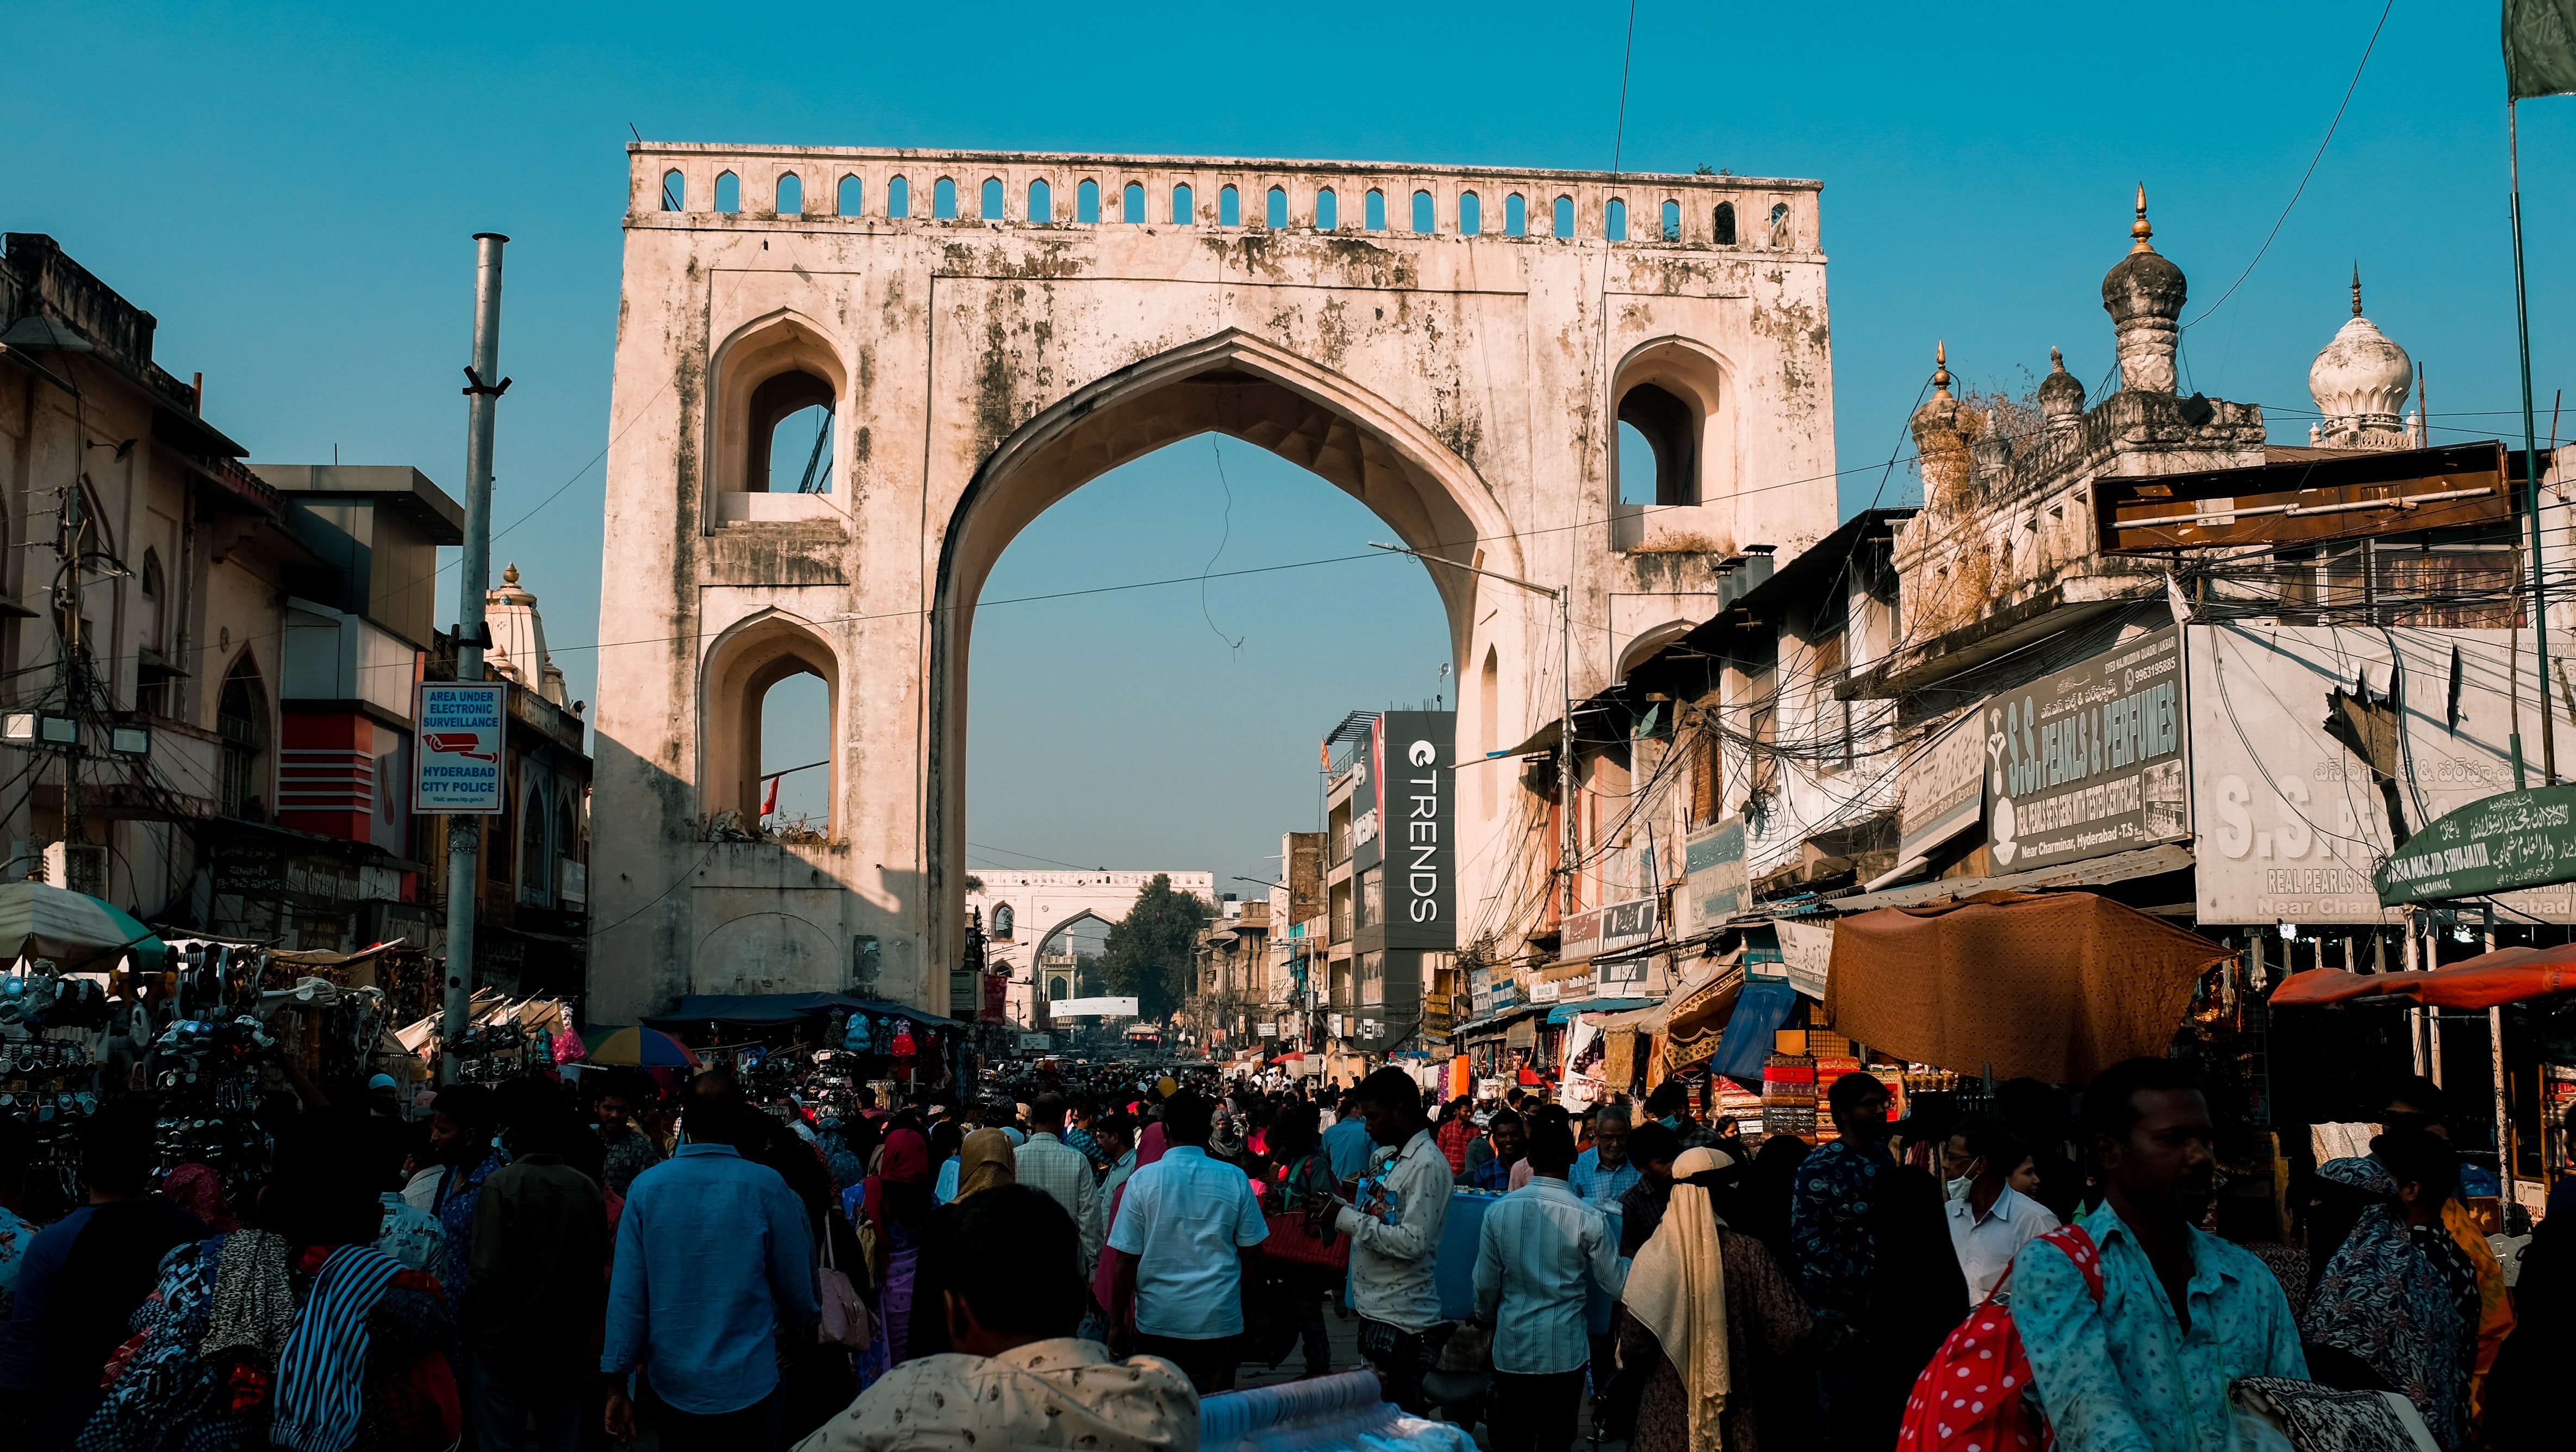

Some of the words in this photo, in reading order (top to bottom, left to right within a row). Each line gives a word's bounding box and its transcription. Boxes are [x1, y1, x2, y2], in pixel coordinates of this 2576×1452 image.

[2105, 660, 2115, 675] SYED
[2135, 656, 2176, 683] 9963195885
[430, 691, 457, 702] AREA
[459, 691, 494, 702] UNDER
[2077, 691, 2084, 706] &
[430, 704, 493, 714] ELECTRONIC
[423, 717, 499, 727] SURVEILLANCE
[2008, 696, 2041, 798] S.S.
[2042, 712, 2088, 788] PEARLS
[2091, 707, 2101, 775] &
[2104, 680, 2177, 771] PERFUMES
[424, 766, 496, 777] HYDERABAD
[2416, 758, 2435, 782] &
[421, 781, 449, 792] CITY
[452, 782, 495, 793] POLICE
[2072, 789, 2086, 825] WITH
[2086, 784, 2106, 822] TESTED
[2106, 774, 2141, 817] CERTIFICATE
[1905, 806, 1937, 836] Charminar
[1938, 795, 1954, 815] Book
[1410, 769, 1438, 923] TRENDS
[2021, 844, 2038, 859] Near
[2038, 838, 2076, 856] Charminar,
[2077, 825, 2117, 851] Hyderabad
[2410, 852, 2444, 879] MASJID
[2444, 843, 2490, 873] SHUJAIYA
[308, 864, 337, 905] Crockery
[338, 870, 359, 902] House
[2267, 869, 2303, 894] REAL
[2304, 869, 2355, 894] PEARLS
[2257, 897, 2312, 915] Near
[1789, 967, 1814, 981] Charminar
